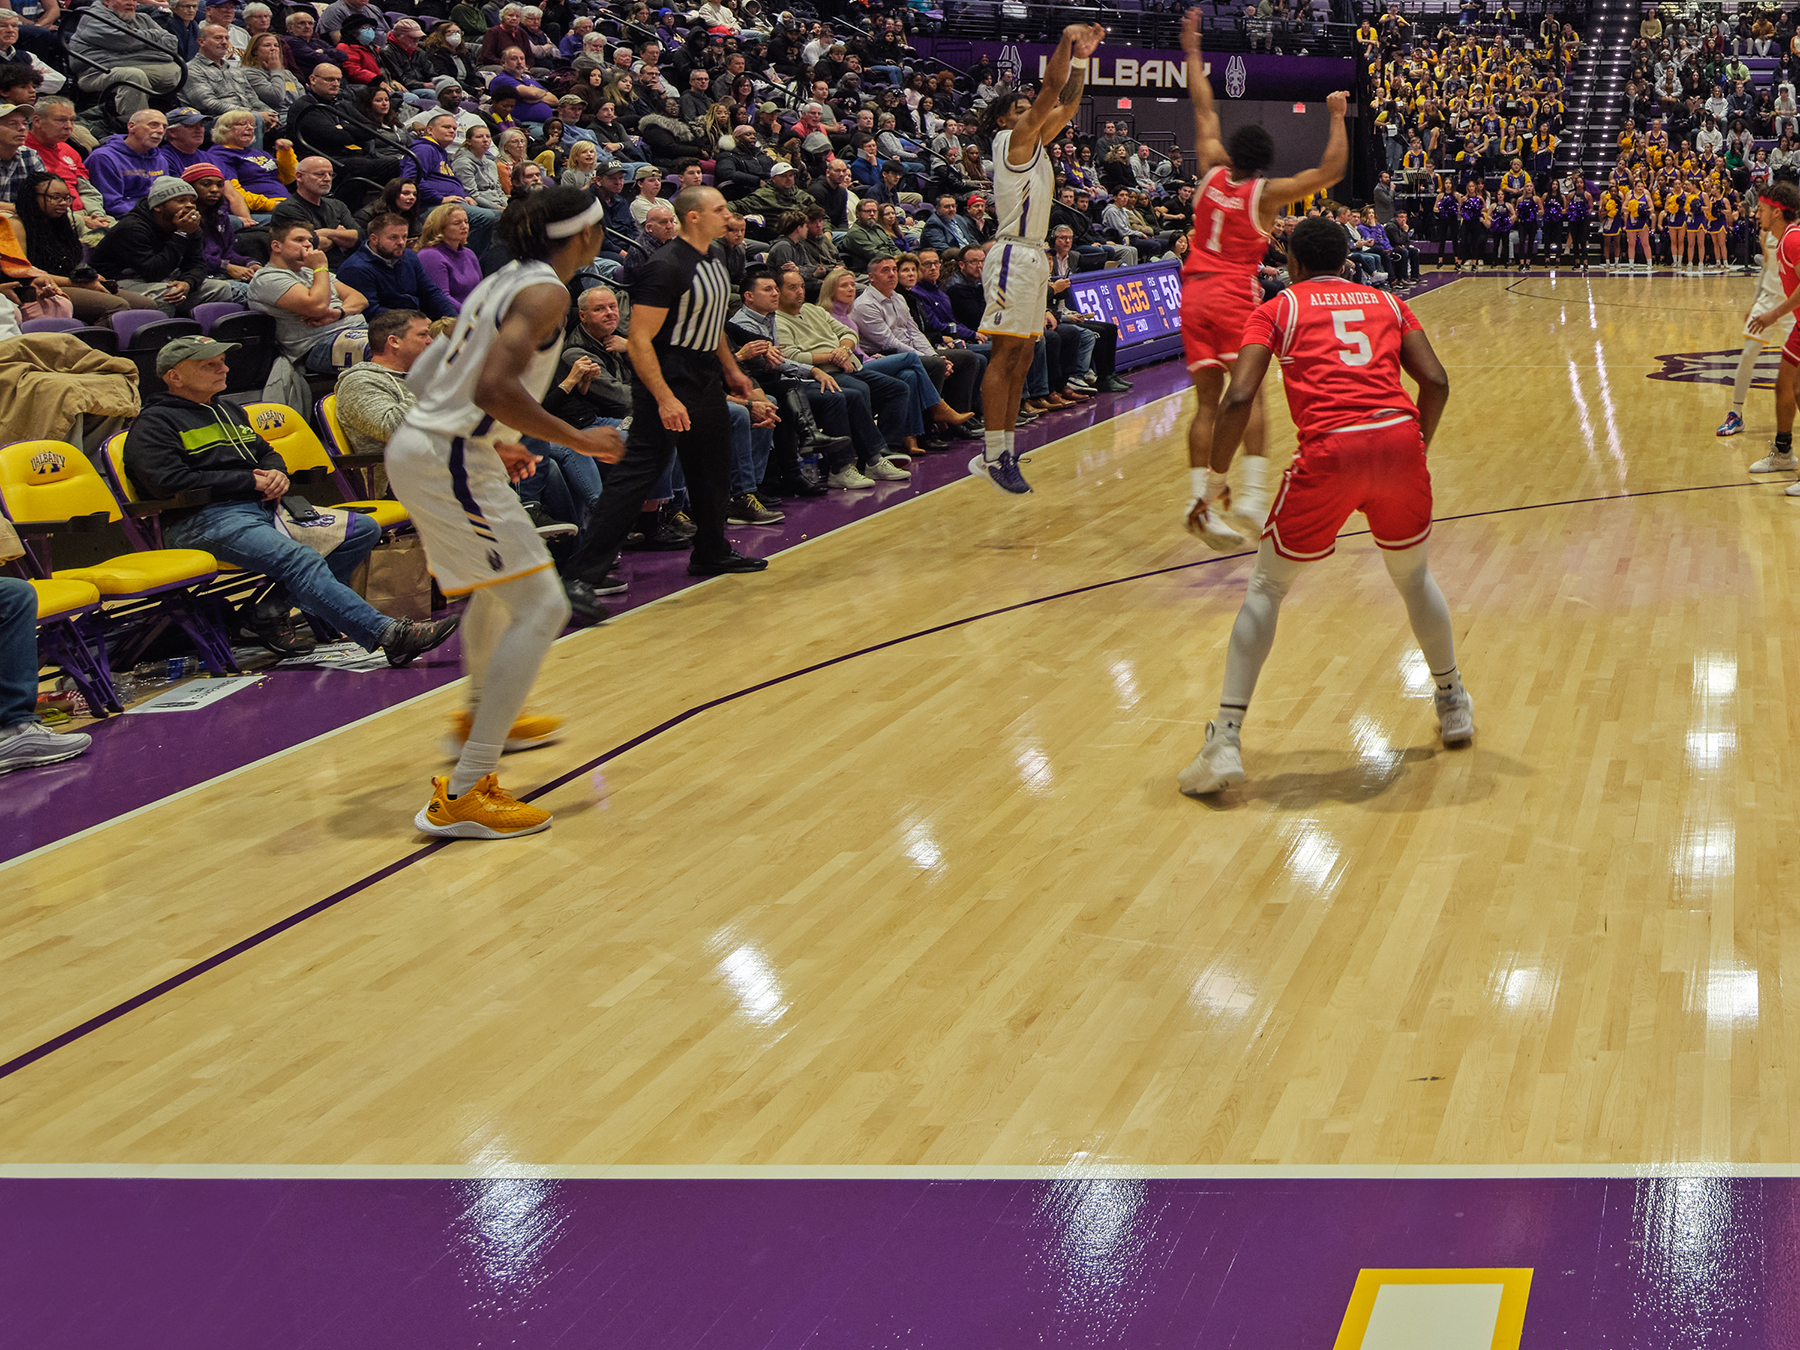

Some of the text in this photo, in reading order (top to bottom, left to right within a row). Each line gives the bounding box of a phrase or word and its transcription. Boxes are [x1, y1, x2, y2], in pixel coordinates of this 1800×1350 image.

[1206, 208, 1225, 253] 1
[1075, 289, 1106, 322] 53
[1116, 281, 1150, 315] 6:55
[1158, 274, 1182, 310] 58
[1310, 291, 1379, 307] ALEXANDER
[1331, 310, 1373, 366] 5
